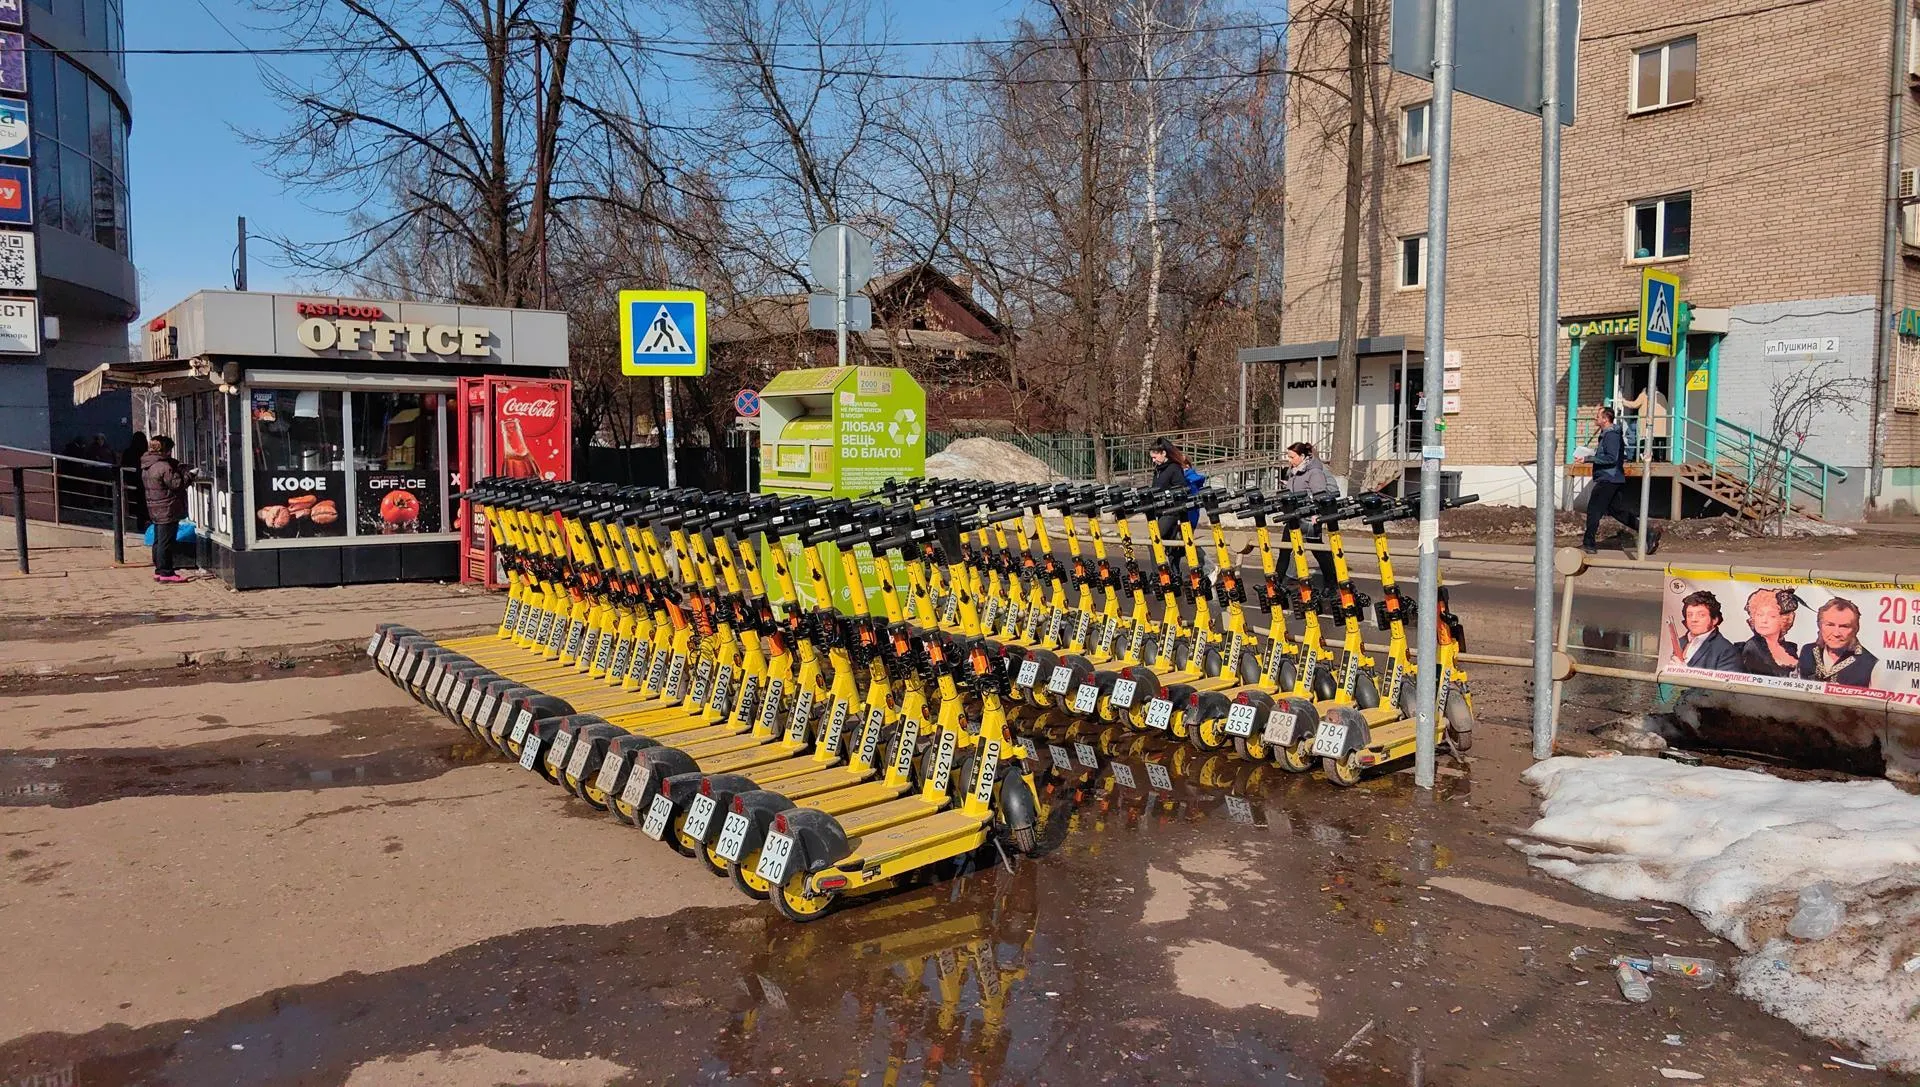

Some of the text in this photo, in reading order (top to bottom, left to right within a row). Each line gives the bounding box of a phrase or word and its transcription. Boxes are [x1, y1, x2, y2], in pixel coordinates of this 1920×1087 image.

[1587, 317, 1640, 336] АПТЕ
[297, 317, 491, 357] OFFICE
[1826, 340, 1834, 351] 2
[1693, 374, 1706, 384] 24
[503, 397, 559, 418] Coca-Cola
[841, 421, 884, 432] ЛЮБАЯ
[841, 435, 876, 447] ВЕЩЬ
[841, 448, 901, 458] ВО БЛАГО!
[272, 476, 327, 492] КОФЕ
[1760, 577, 1791, 585] БИЛЕТЫ
[1878, 596, 1907, 624] 20
[612, 639, 630, 677] 533293
[630, 640, 648, 679] 328734
[1022, 662, 1037, 673] 282
[1269, 642, 1282, 680] 299343
[1886, 659, 1920, 673] МАРИЯ
[647, 650, 667, 690] 303074
[666, 655, 685, 696] 338661
[1020, 674, 1033, 684] 188
[1055, 668, 1070, 678] 747
[1345, 655, 1358, 695] 202353
[711, 665, 731, 709] 530293
[1052, 680, 1066, 691] 715
[1080, 687, 1096, 698] 426
[1117, 681, 1134, 692] 736
[1827, 685, 1886, 698] TICKETLAND
[737, 676, 758, 722] HH853A
[763, 680, 782, 727] 409560
[1076, 699, 1093, 711] 271
[1113, 694, 1130, 705] 448
[1151, 701, 1169, 713] 299
[792, 691, 812, 739] 136744
[1148, 713, 1166, 727] 343
[1231, 705, 1253, 719] 202
[1271, 713, 1293, 727] 628
[827, 701, 847, 752] HA489A
[861, 709, 882, 762] 200379
[1228, 719, 1250, 733] 353
[1321, 723, 1343, 739] 784
[898, 720, 917, 773] 159919
[1316, 739, 1339, 754] 036
[935, 732, 955, 789] 232190
[978, 742, 999, 800] 318210
[652, 797, 669, 817] 200
[695, 797, 713, 817] 159
[645, 816, 663, 835] 379
[686, 816, 706, 836] 919
[725, 815, 746, 836] 232
[721, 837, 740, 857] 190
[766, 836, 788, 857] 318
[759, 857, 782, 879] 210
